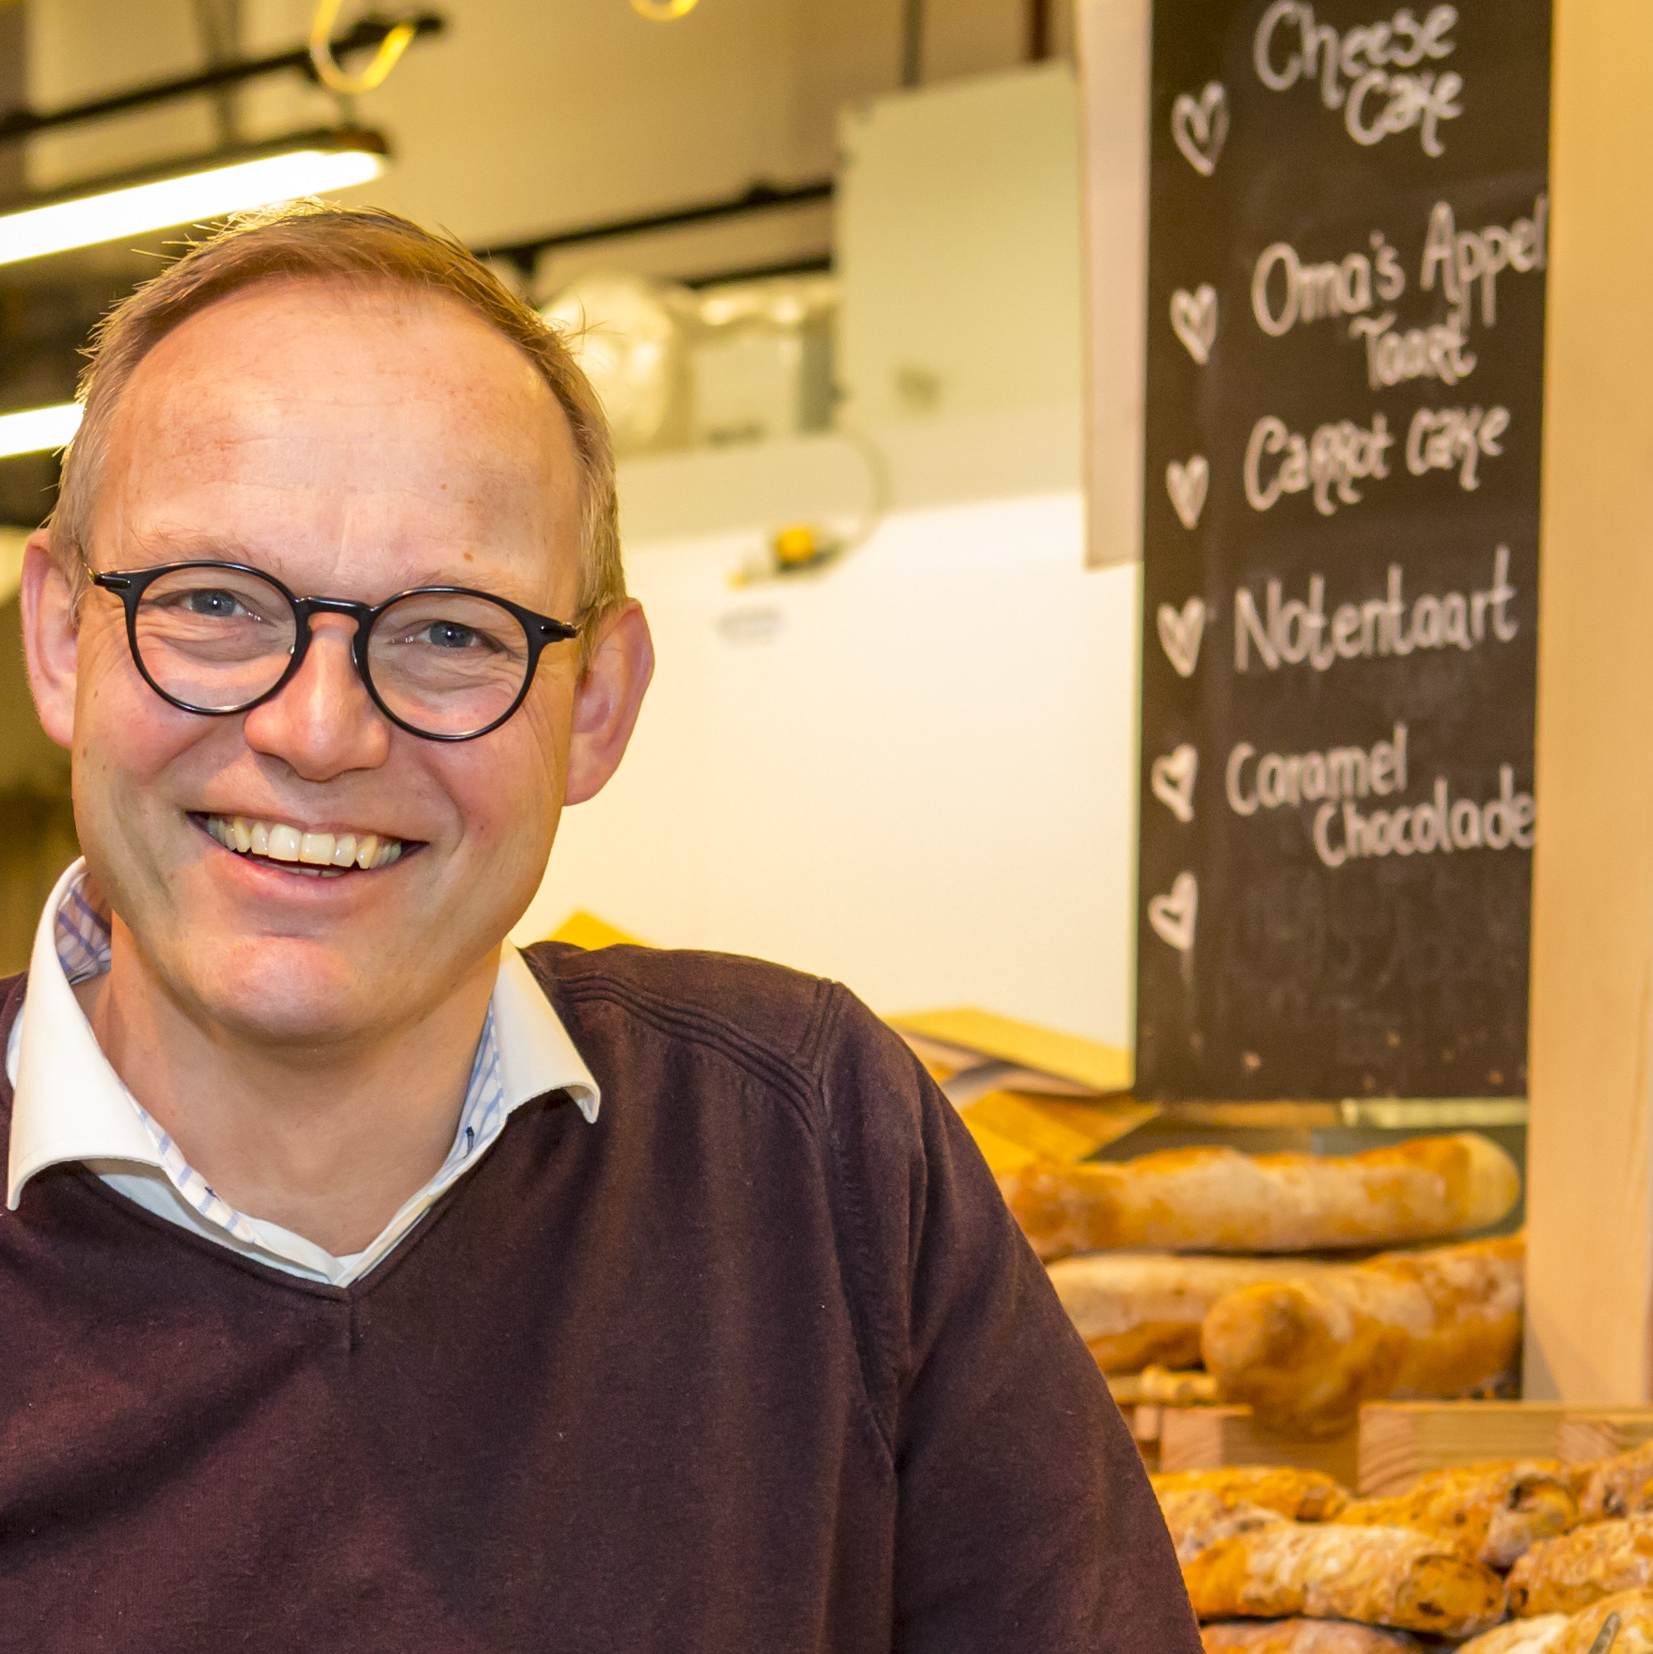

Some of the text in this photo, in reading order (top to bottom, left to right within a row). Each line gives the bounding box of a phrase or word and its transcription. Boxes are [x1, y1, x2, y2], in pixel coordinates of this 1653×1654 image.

[1253, 0, 1458, 109] Cheese
[1251, 194, 1550, 337] Oma's Appel
[1348, 311, 1477, 392] Taart
[1234, 544, 1519, 674] Notentaart
[1226, 722, 1408, 815] Caramel
[1313, 763, 1537, 868] Chocolade
